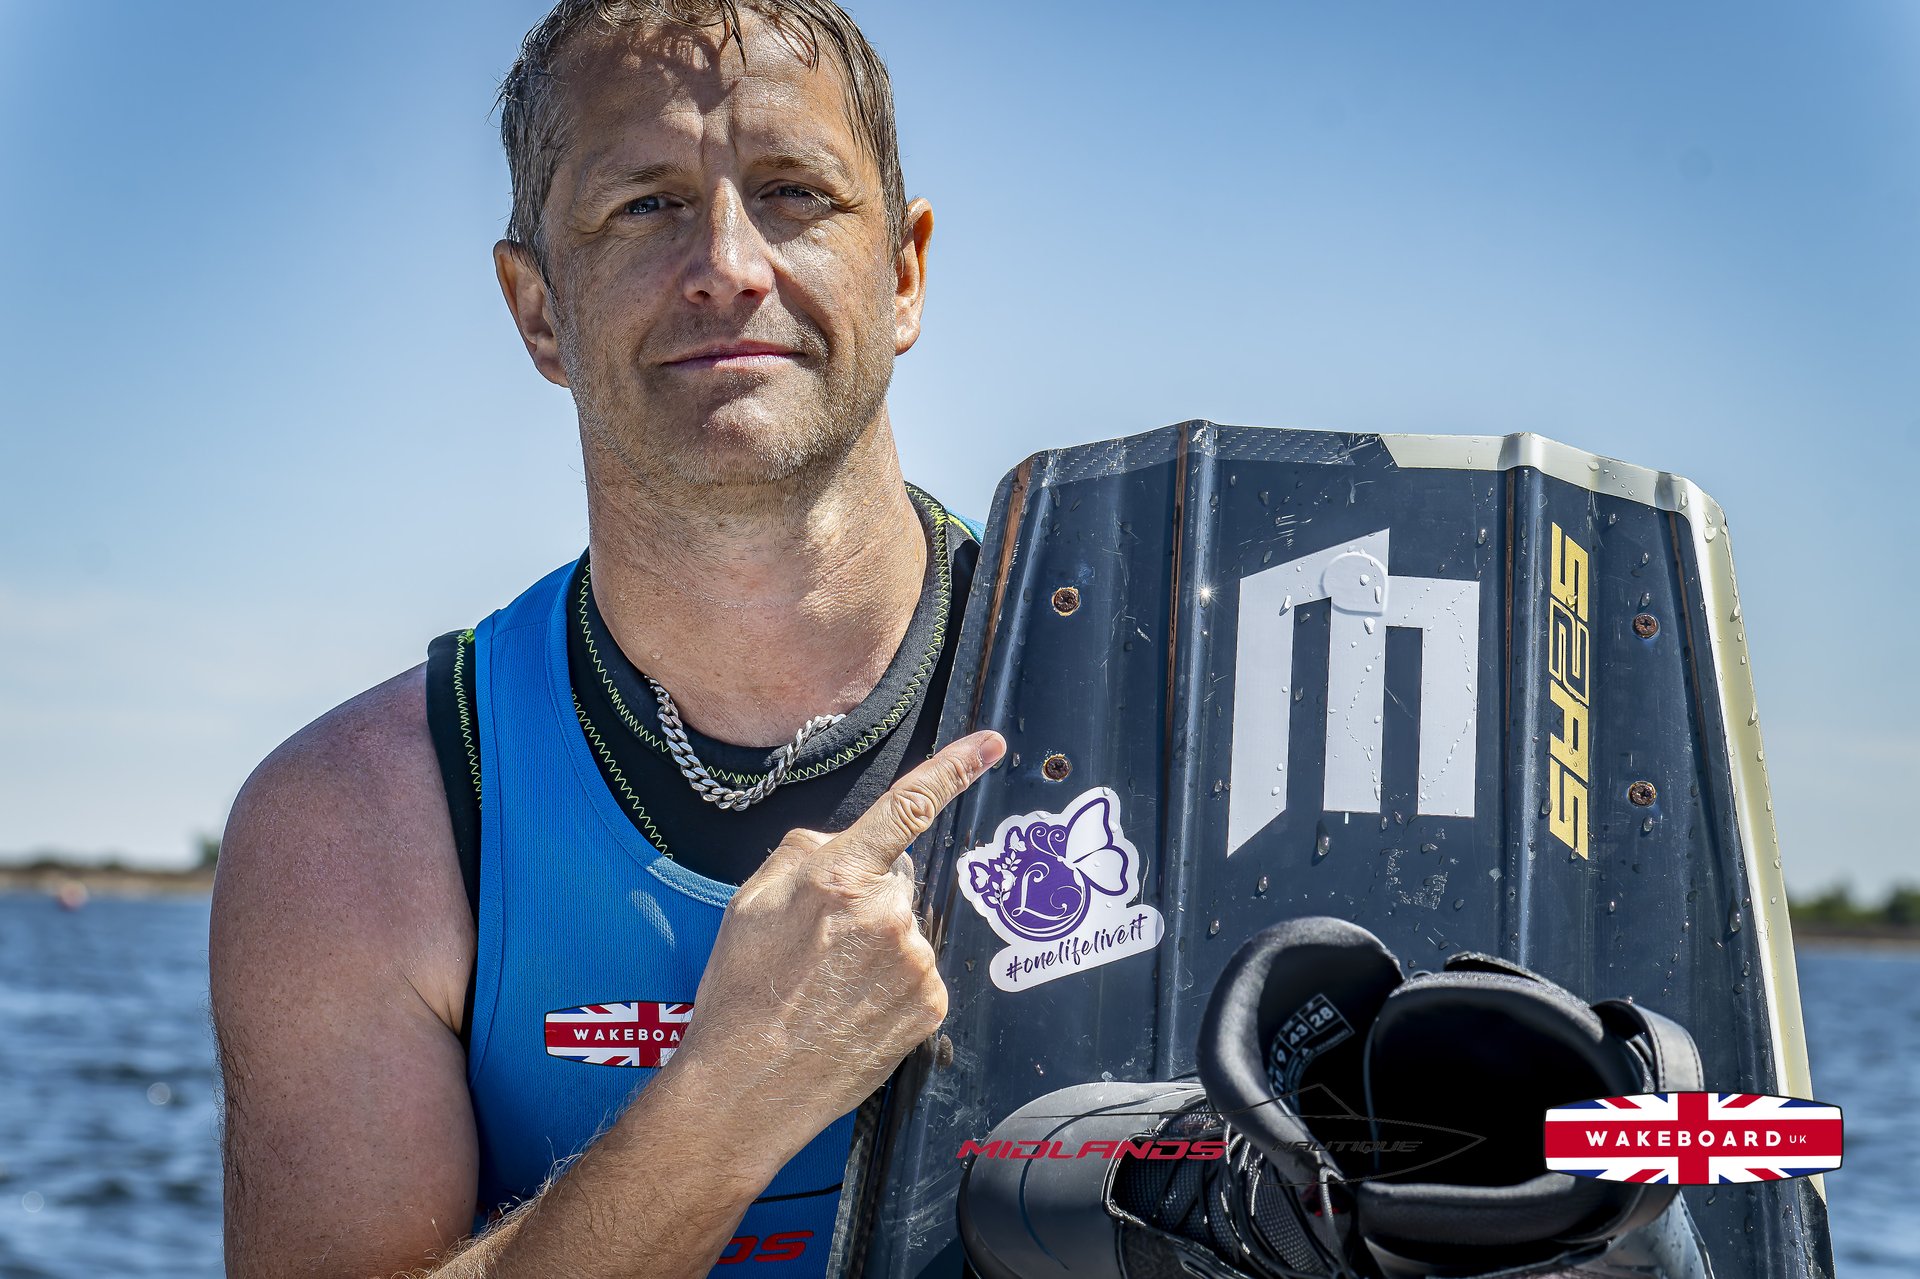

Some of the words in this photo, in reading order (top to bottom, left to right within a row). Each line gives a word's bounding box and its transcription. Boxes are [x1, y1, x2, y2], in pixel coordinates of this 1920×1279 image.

[1006, 913, 1148, 982] #onelifeliveit
[574, 1028, 680, 1042] WAKEBOA
[1276, 1049, 1287, 1065] 9
[1289, 1023, 1309, 1046] 43
[1309, 1006, 1335, 1028] 28
